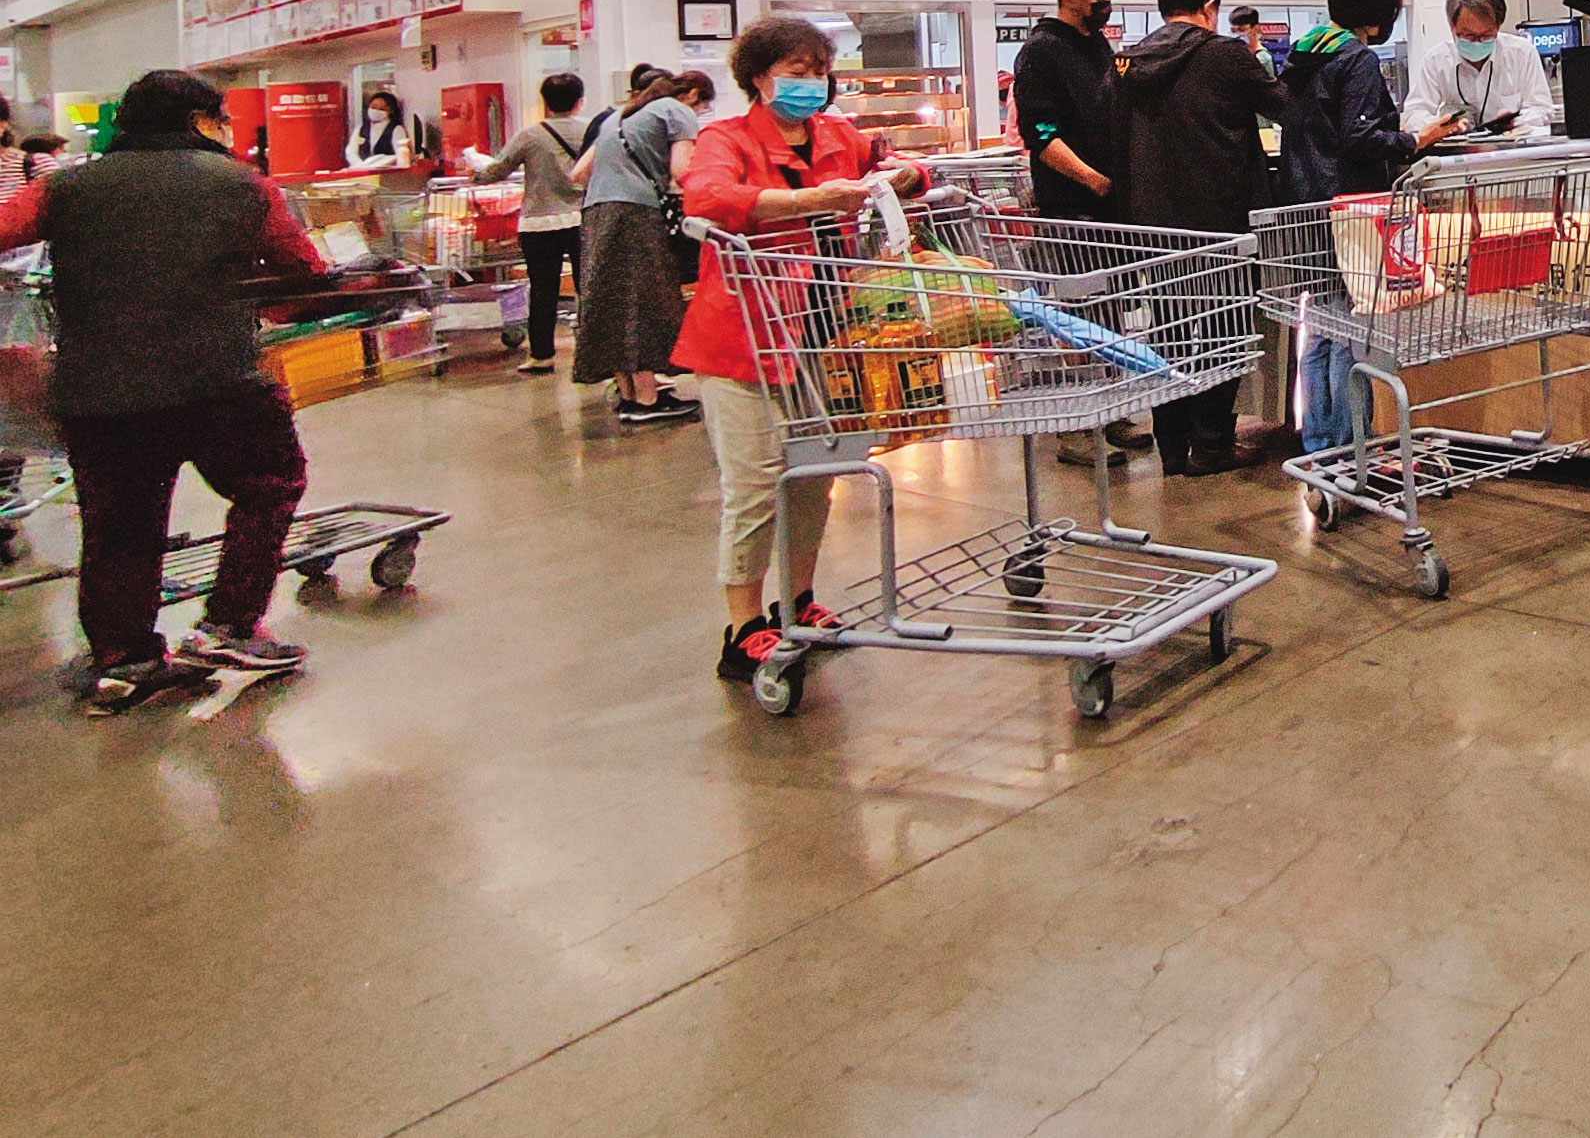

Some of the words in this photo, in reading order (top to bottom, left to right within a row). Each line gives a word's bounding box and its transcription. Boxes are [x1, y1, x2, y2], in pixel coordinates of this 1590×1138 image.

[1099, 26, 1122, 40] SED
[1261, 24, 1289, 34] CLOSED
[1533, 31, 1567, 48] pepsi
